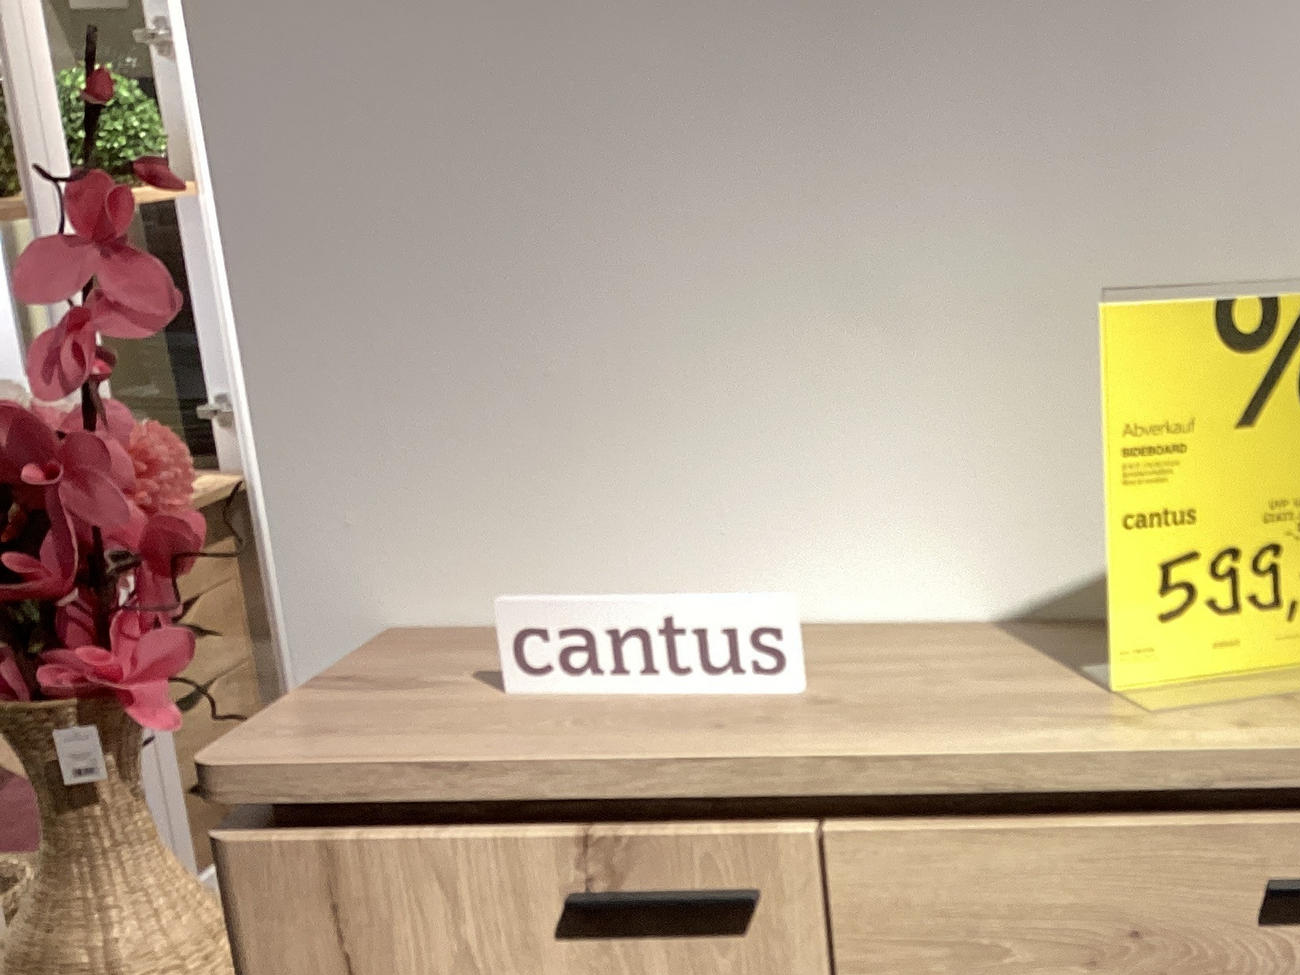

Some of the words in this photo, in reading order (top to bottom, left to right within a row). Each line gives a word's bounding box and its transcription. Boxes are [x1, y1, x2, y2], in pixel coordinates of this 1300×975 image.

[1121, 416, 1196, 438] Abverkauf
[1121, 443, 1188, 458] SIDEBOARD
[1121, 508, 1198, 530] cantus
[512, 616, 787, 677] cantus
